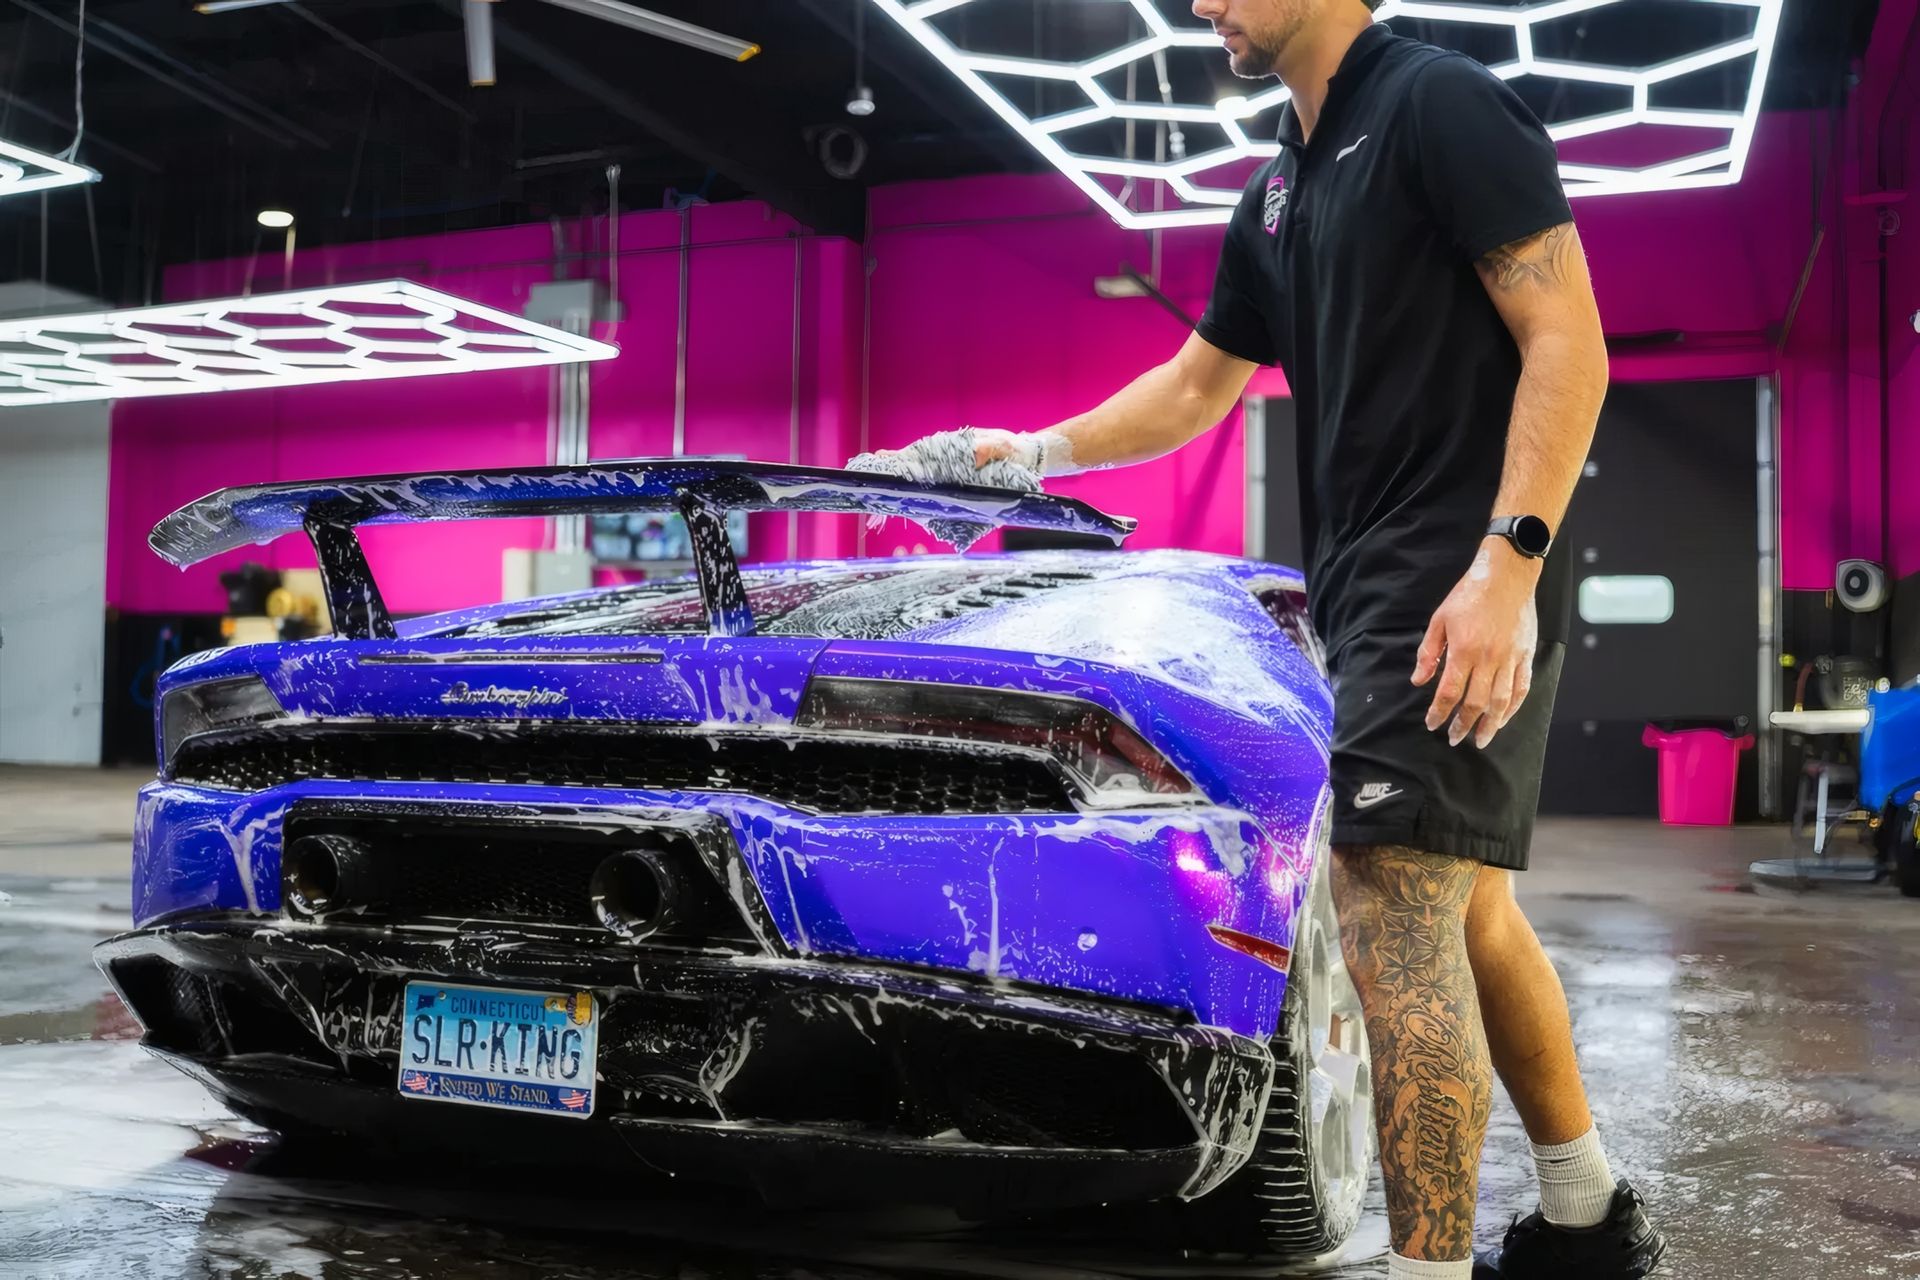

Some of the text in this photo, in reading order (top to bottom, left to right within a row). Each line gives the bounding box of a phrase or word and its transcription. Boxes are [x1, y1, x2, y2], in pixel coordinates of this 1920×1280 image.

[1360, 782, 1392, 798] NIKE
[451, 996, 547, 1023] CONNECTICUT
[486, 1080, 506, 1097] WE
